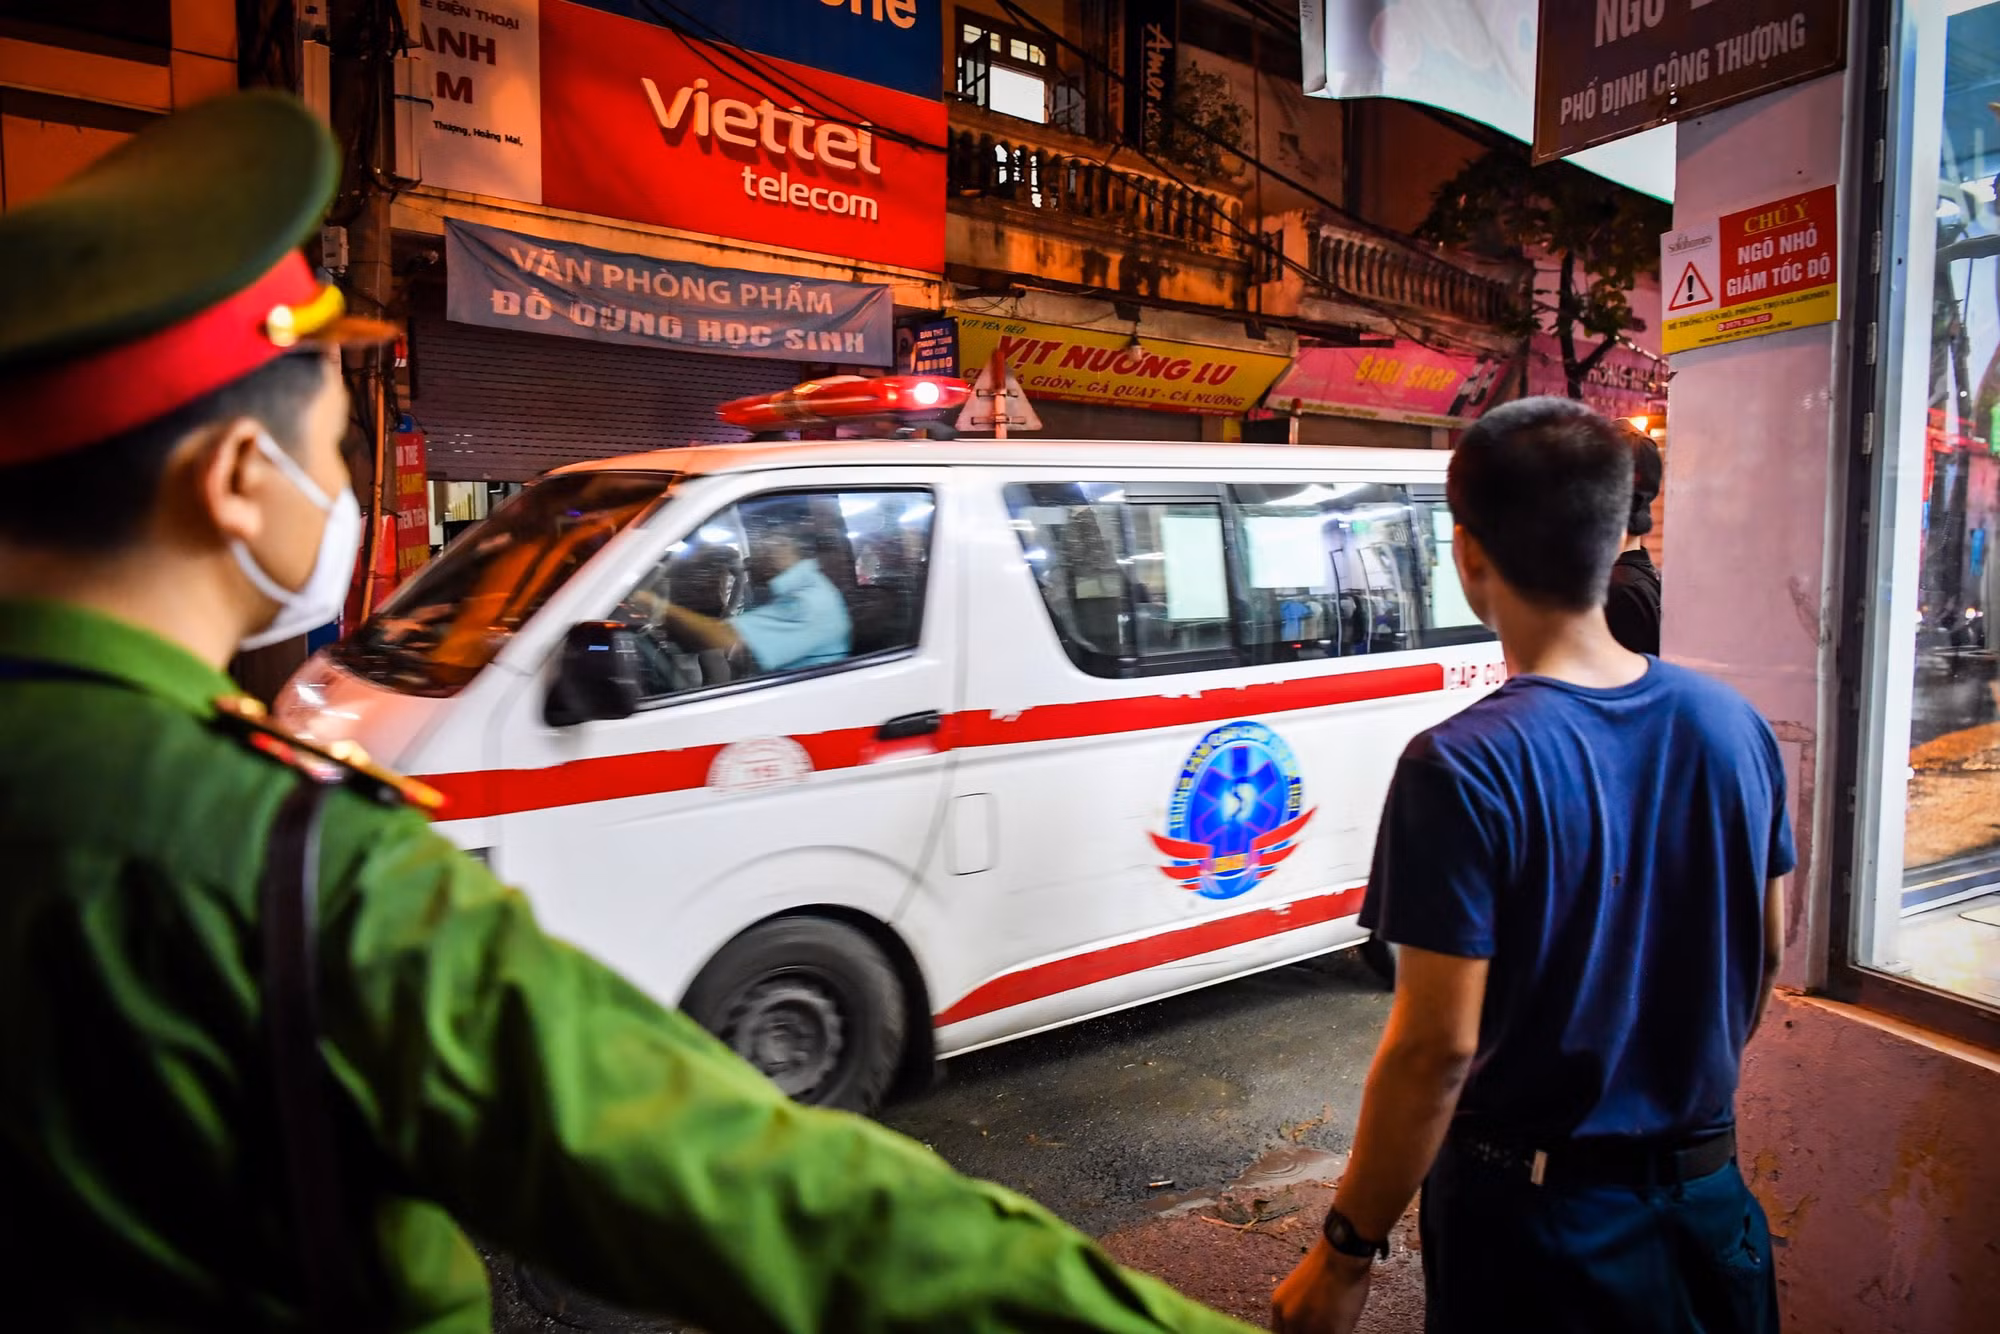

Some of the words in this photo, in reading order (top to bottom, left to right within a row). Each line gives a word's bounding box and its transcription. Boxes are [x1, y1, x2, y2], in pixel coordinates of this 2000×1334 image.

[1560, 76, 1599, 125] PHỐ
[1601, 68, 1648, 116] ĐỊNH
[1653, 51, 1709, 96] CÔNG
[1715, 13, 1806, 69] THƯỢNG
[741, 166, 878, 220] telecom
[1744, 203, 1788, 233] CHÚ
[1794, 198, 1808, 219] Ý
[1738, 236, 1775, 265] NGÕ
[1779, 222, 1817, 255] NHỎ
[510, 248, 592, 286] VĂN
[603, 264, 731, 305] PHÒNG
[740, 282, 833, 315] PHẨM
[1726, 268, 1767, 297] GIẢM
[1772, 258, 1803, 287] TỐC
[1808, 252, 1831, 280] ĐỘ
[490, 287, 552, 321] ĐỒ
[569, 301, 683, 339] DÙNG
[698, 319, 773, 349] HỌC
[784, 328, 865, 354] SINH
[999, 335, 1063, 369] VỊT
[1192, 362, 1238, 386] LU
[1113, 384, 1161, 399] QUAY
